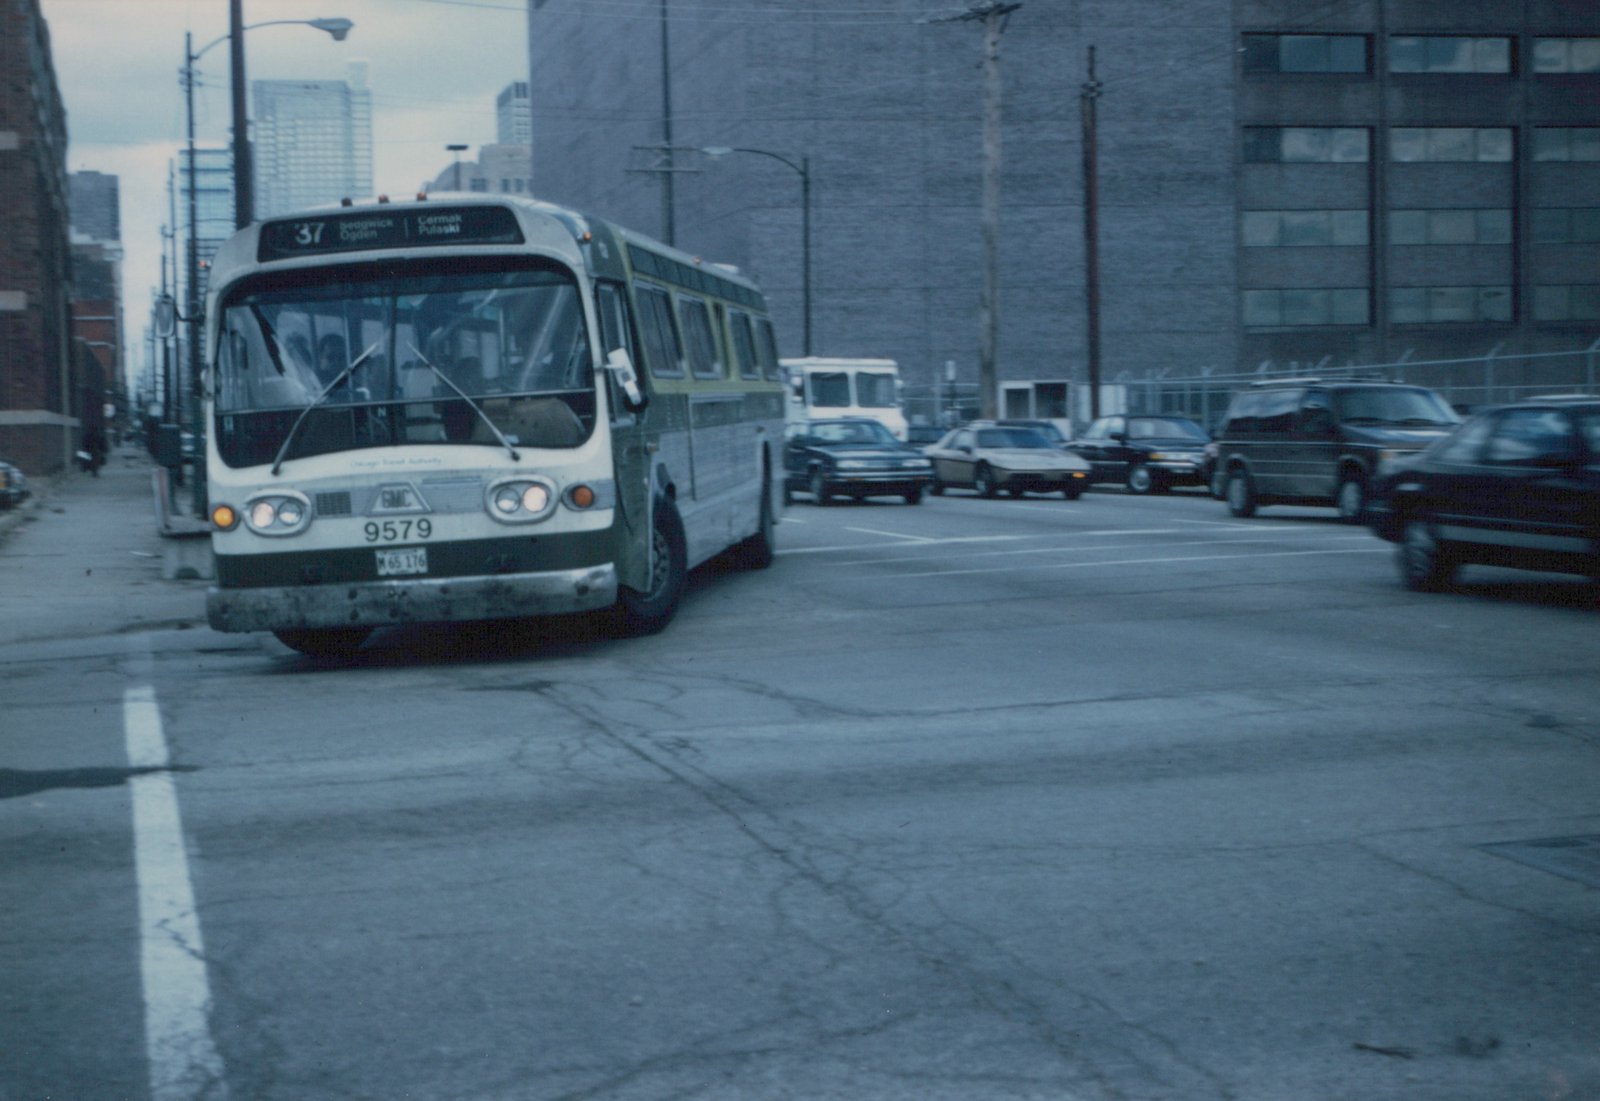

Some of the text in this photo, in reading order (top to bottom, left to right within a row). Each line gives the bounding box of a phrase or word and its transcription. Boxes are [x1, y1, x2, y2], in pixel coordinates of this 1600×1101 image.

[418, 215, 462, 224] Cermak
[295, 222, 325, 245] 37
[340, 229, 378, 240] Ogden
[418, 224, 460, 235] Pulaski
[382, 489, 412, 508] GMC
[364, 518, 432, 542] 9579
